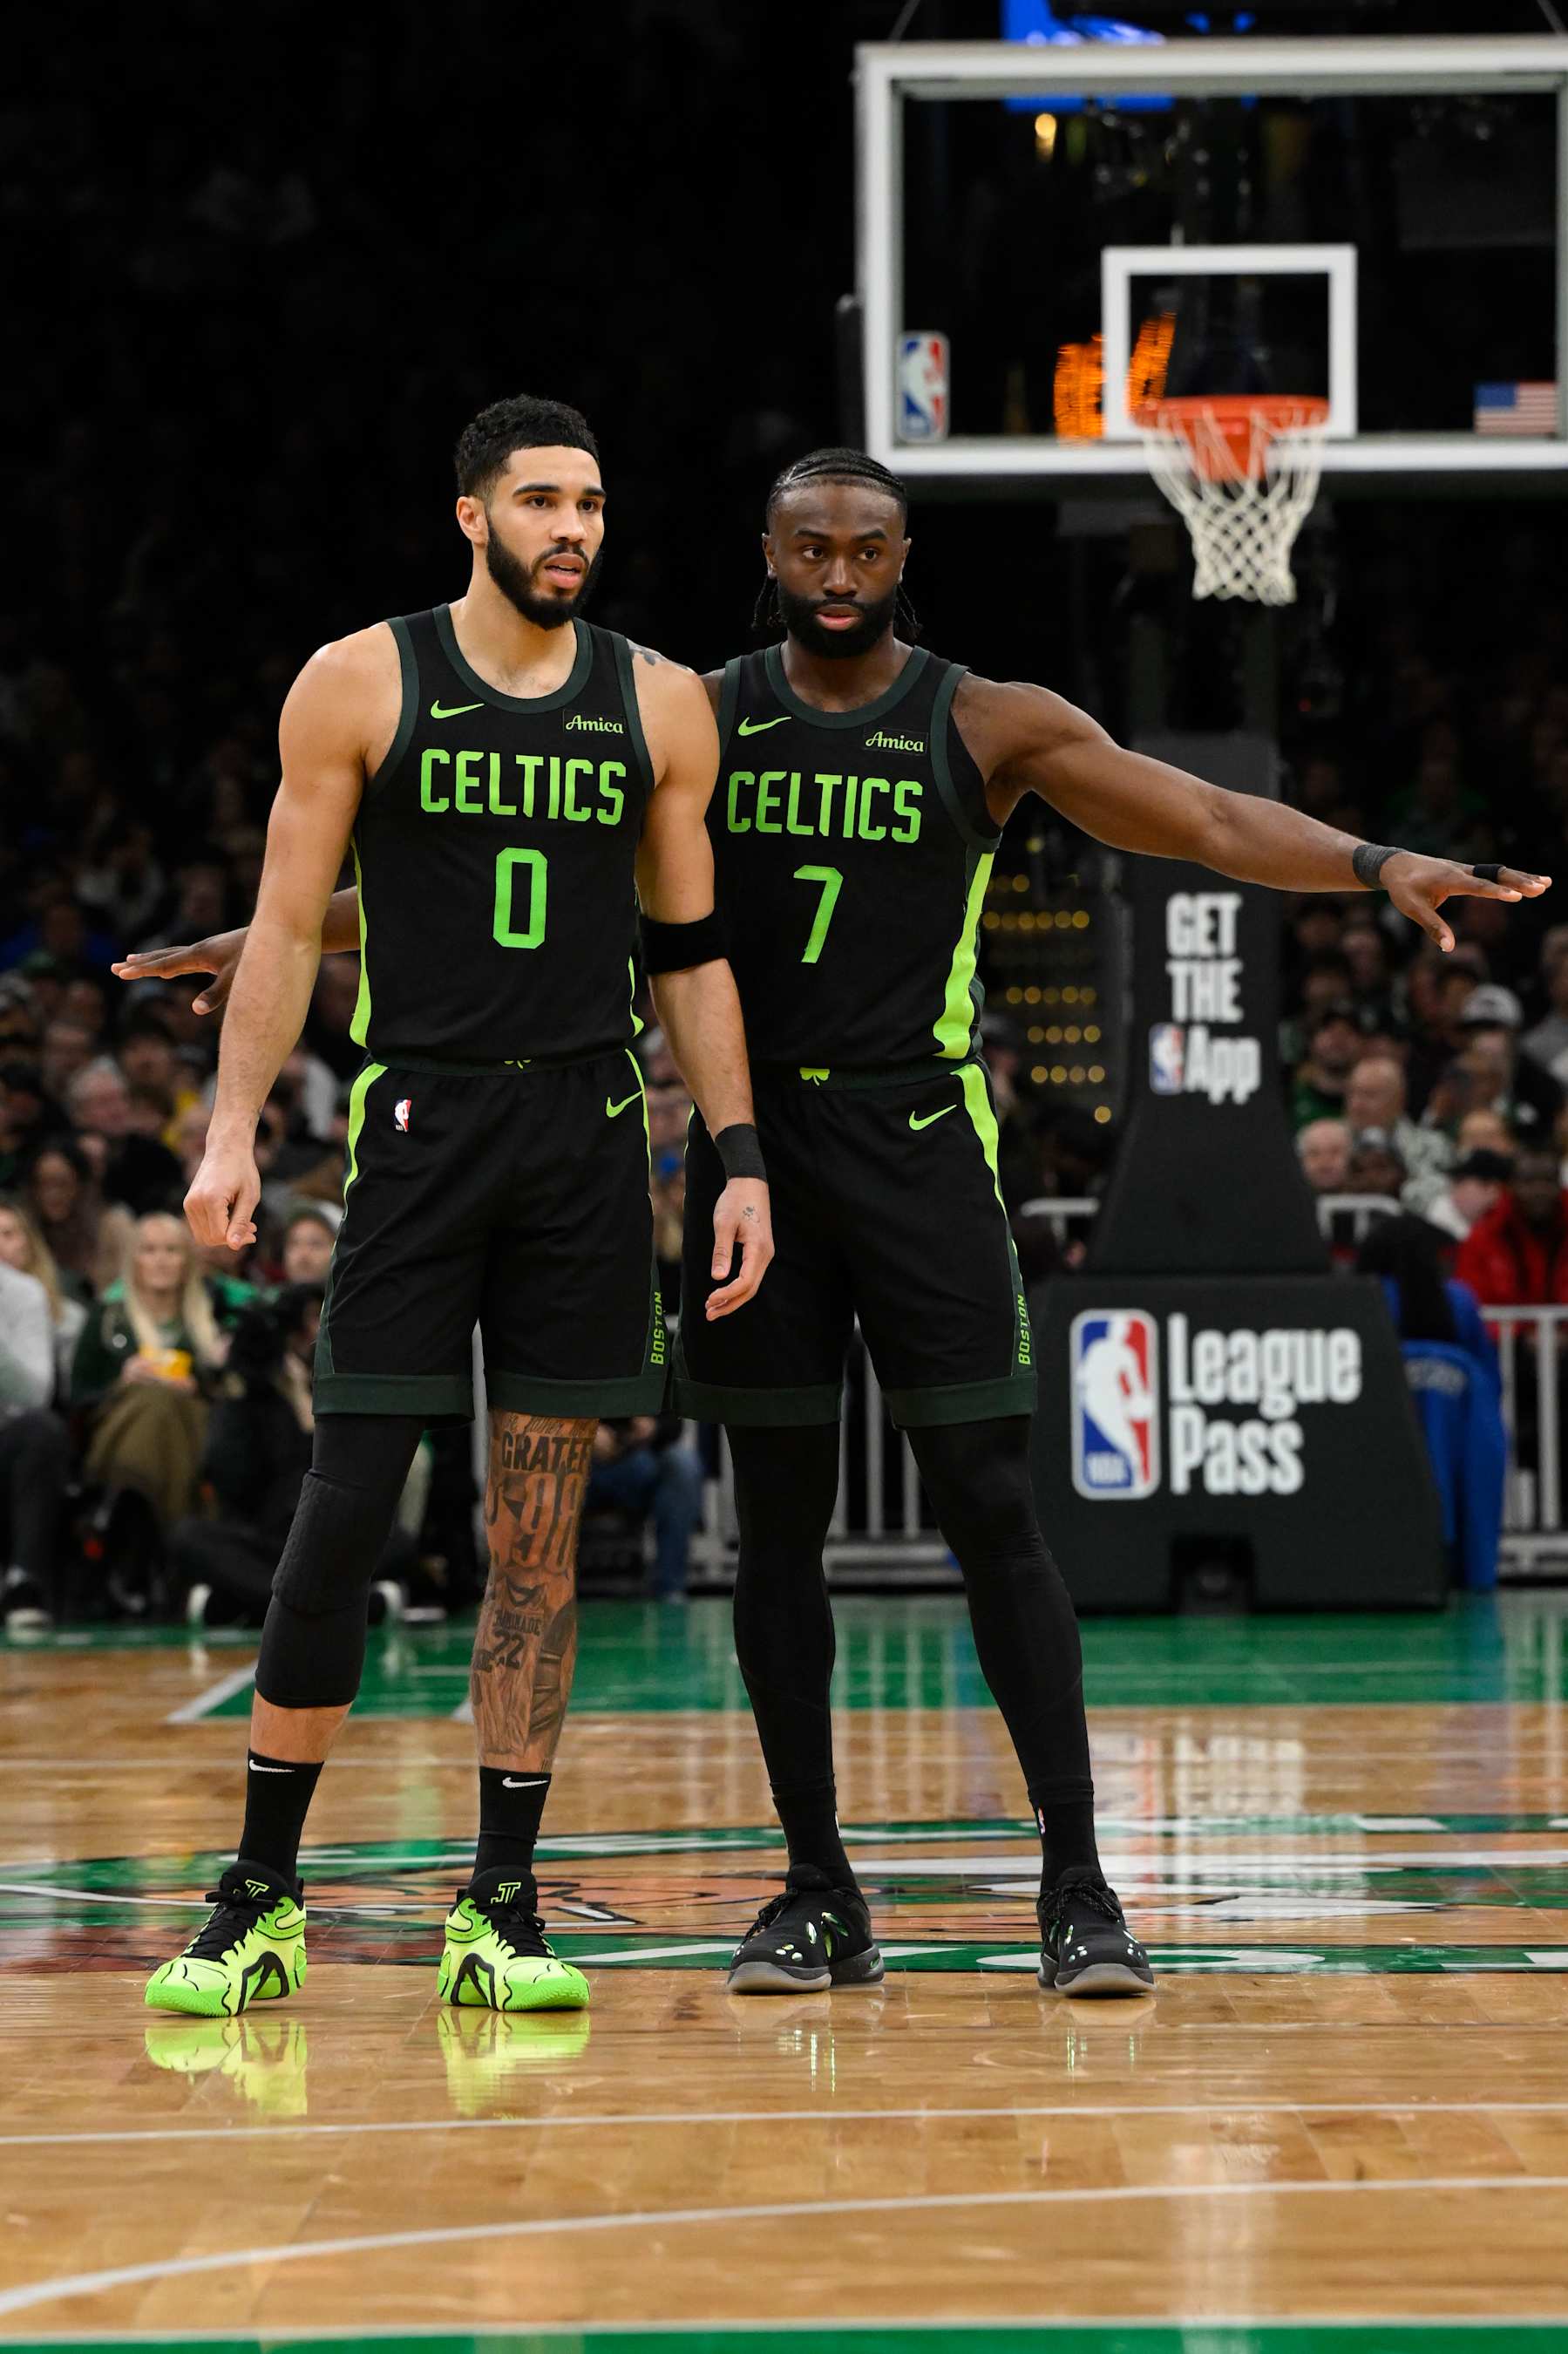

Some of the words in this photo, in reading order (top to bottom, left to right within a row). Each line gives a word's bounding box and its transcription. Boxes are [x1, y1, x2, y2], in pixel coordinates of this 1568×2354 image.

[566, 715, 624, 734] Amica
[865, 731, 924, 752] Amica
[420, 749, 628, 826] CELTICS
[727, 772, 924, 844] CELTICS
[493, 847, 549, 950] 0
[793, 865, 845, 964] 7
[1166, 893, 1243, 957] GET
[1166, 958, 1245, 1023] THE
[1185, 1026, 1262, 1106] App
[650, 1291, 665, 1365] BOSTON
[1017, 1294, 1031, 1365] BOSTON
[1167, 1312, 1362, 1421] League
[1169, 1406, 1306, 1497] Pass
